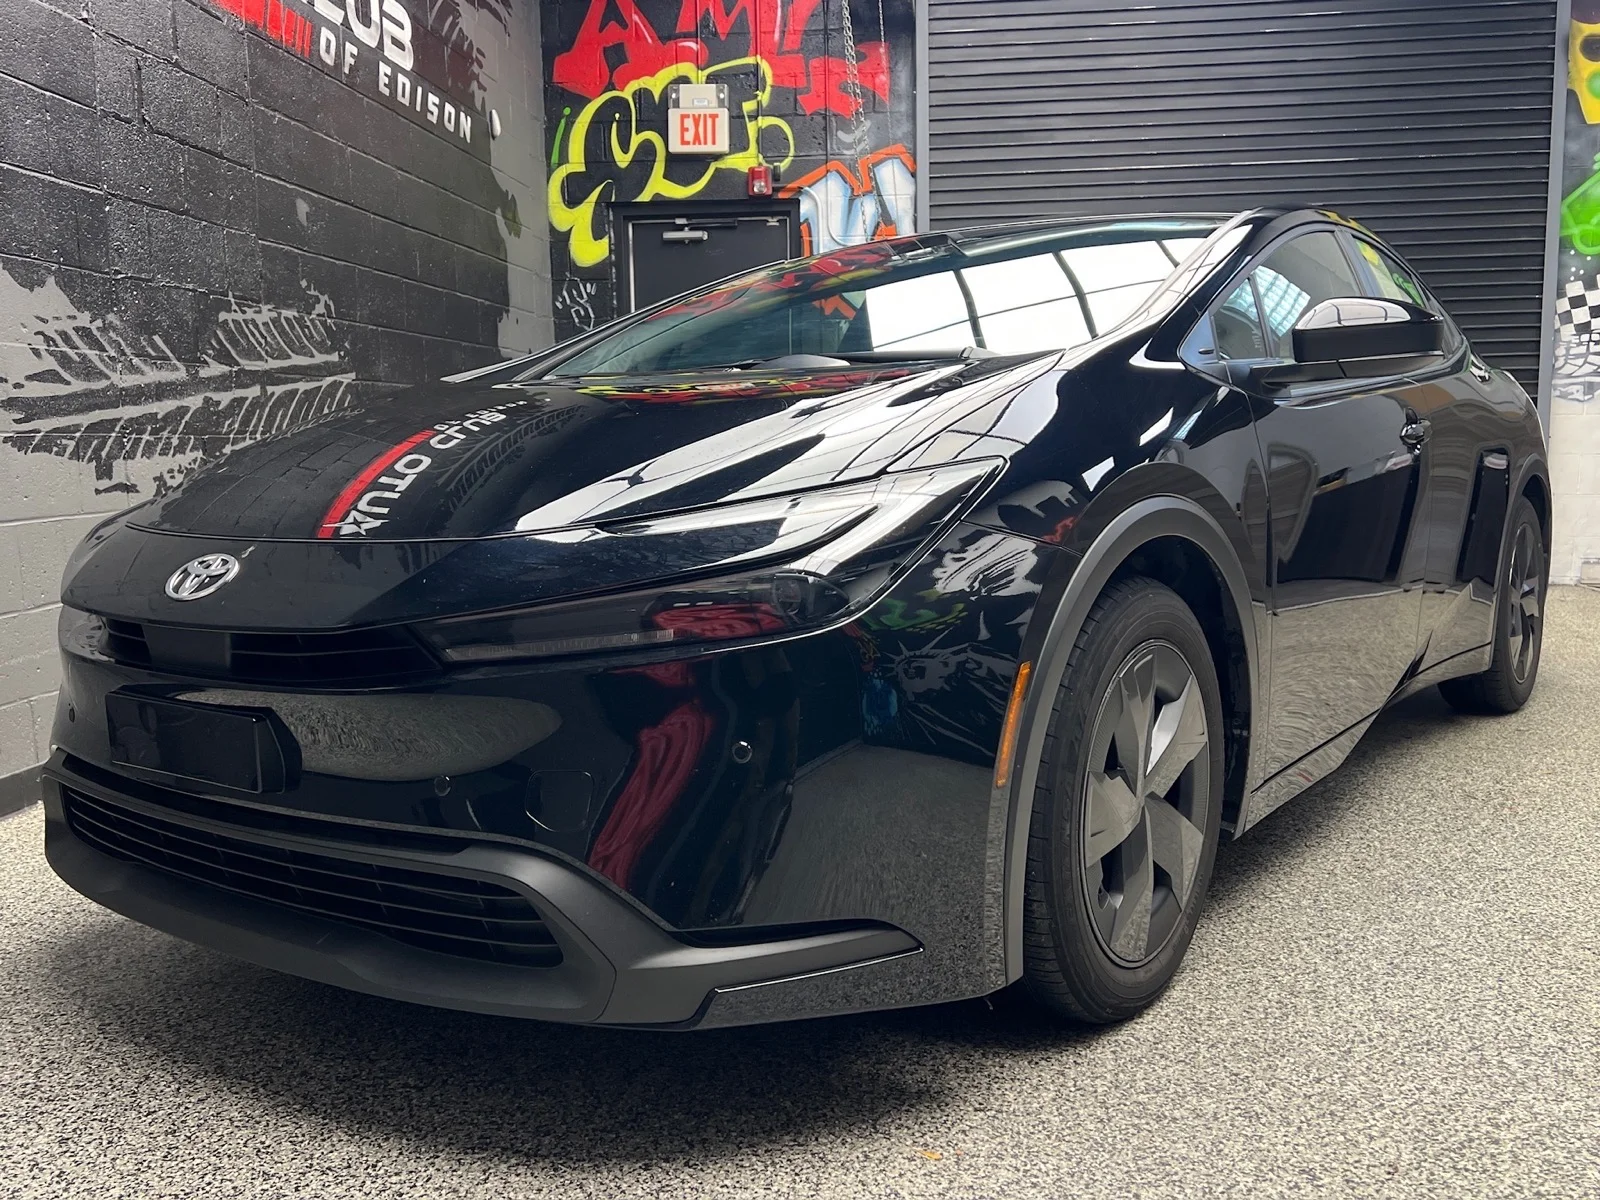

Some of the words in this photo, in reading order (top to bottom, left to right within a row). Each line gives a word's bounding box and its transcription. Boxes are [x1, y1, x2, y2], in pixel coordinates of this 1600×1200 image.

[319, 26, 358, 75] OF
[378, 60, 471, 144] EDISON
[680, 113, 719, 146] EXIT
